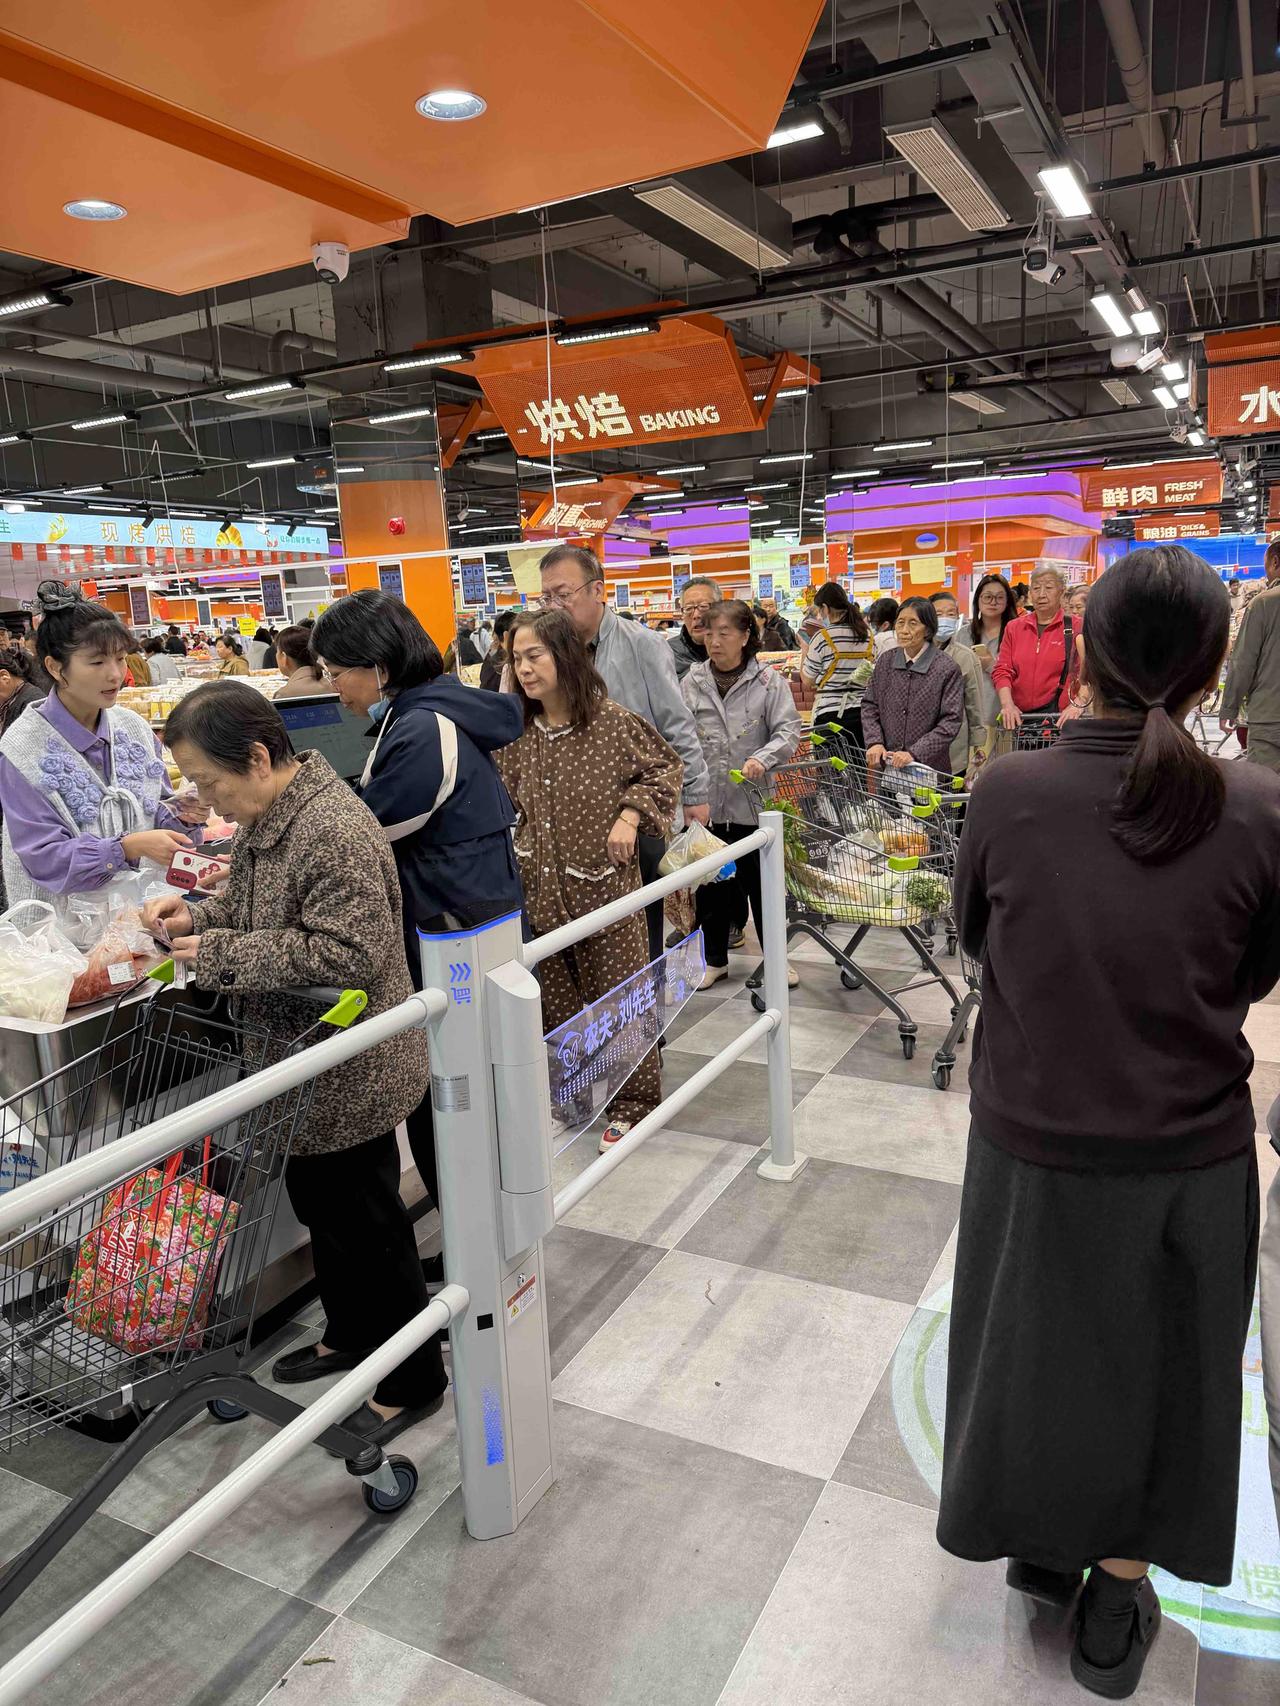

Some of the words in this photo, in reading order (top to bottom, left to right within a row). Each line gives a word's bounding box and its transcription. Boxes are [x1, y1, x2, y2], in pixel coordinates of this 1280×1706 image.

[1237, 385, 1280, 424] 水
[527, 392, 634, 445] 烘焙
[639, 405, 719, 433] BAKING
[1102, 484, 1158, 508] 鲜肉
[1164, 480, 1203, 493] FRESH
[1164, 492, 1197, 504] MEAT
[100, 521, 196, 545] 现烤烘焙
[583, 978, 657, 1056] 农夫·刘先生
